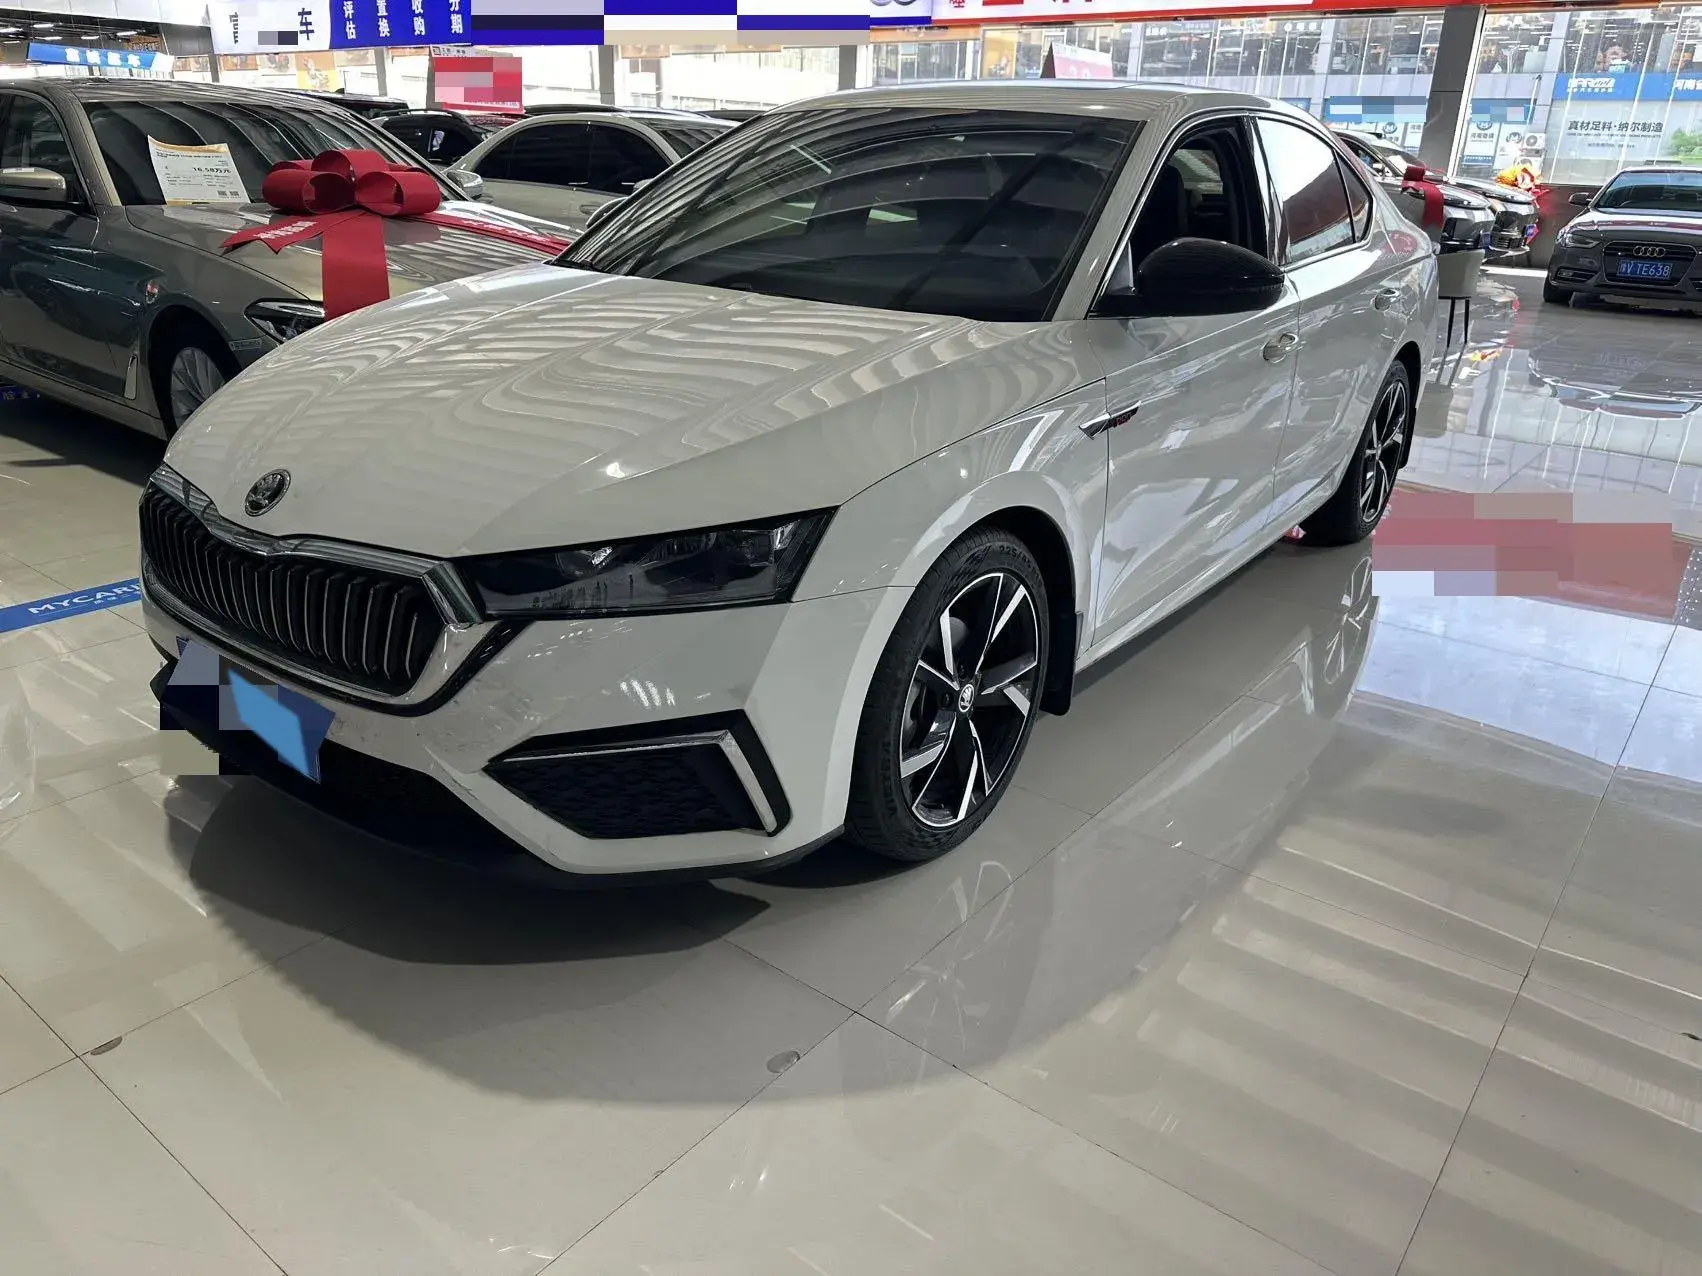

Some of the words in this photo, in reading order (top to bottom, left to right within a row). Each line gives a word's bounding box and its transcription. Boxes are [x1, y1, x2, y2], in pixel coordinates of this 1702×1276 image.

[342, 0, 357, 40] 评估
[1567, 120, 1664, 133] 真材足料·纳尔制造
